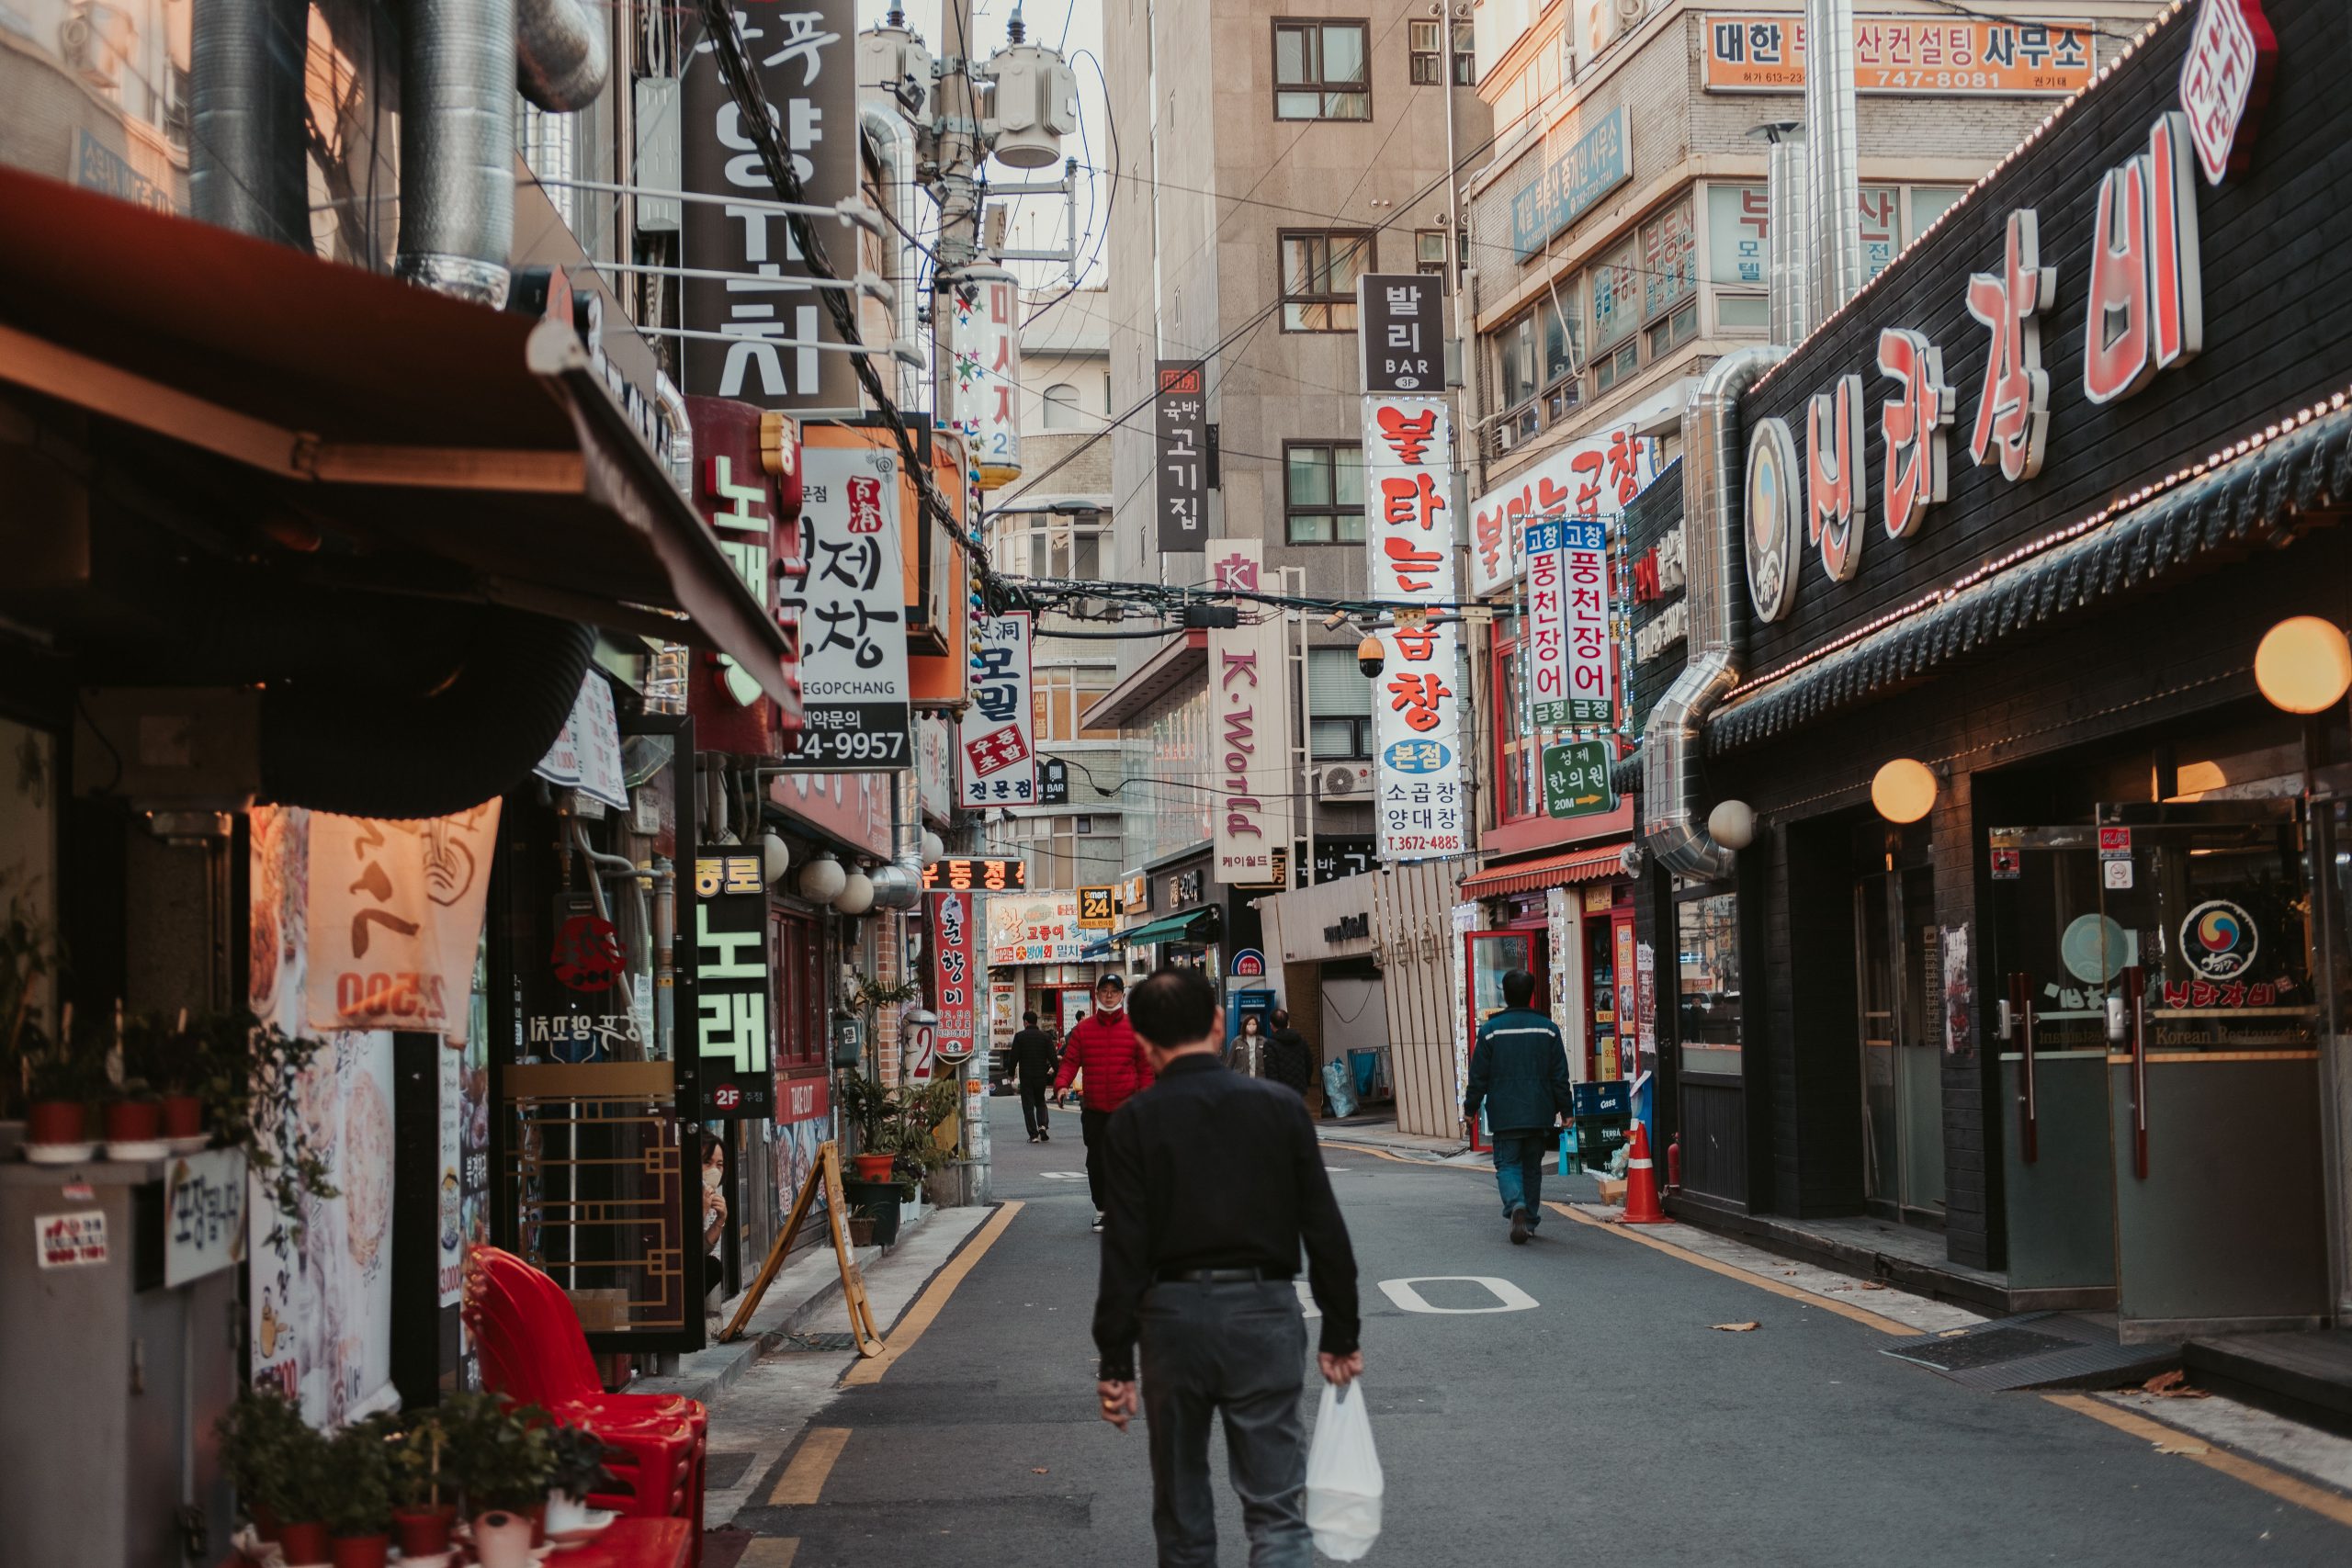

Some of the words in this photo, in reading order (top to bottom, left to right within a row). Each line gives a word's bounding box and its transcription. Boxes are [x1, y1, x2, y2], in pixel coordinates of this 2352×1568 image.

[695, 10, 841, 87] 푸
[1714, 22, 1781, 62] 대한
[1983, 27, 2088, 69] 사무소
[1877, 71, 1999, 88] 747-8081
[1738, 240, 1761, 281] 모텔
[1386, 286, 1422, 354] 발리
[1385, 359, 1430, 374] BAR
[1401, 378, 1415, 388] 3F
[1162, 399, 1200, 422] 육방
[1166, 427, 1199, 531] 고기집
[1529, 525, 1558, 551] 고창
[1566, 525, 1602, 548] 고창
[1532, 552, 1562, 698] 풍천장어
[1569, 552, 1605, 698] 풍천장어
[977, 647, 1021, 723] 모밀
[1534, 701, 1565, 723] 금정
[1573, 700, 1609, 720] 금정
[786, 733, 904, 760] 24-9957
[1392, 743, 1442, 771] 본점
[1558, 747, 1589, 767] 성제
[969, 779, 1033, 799] 전문점
[1046, 783, 1064, 793] BAR
[1548, 765, 1605, 795] 한의원
[1386, 783, 1456, 805] 소곱창
[1554, 796, 1575, 811] 20M
[1387, 807, 1457, 830] 양대창
[1387, 834, 1459, 852] T.3672-4885
[1223, 855, 1269, 868] 케이월드
[1084, 890, 1108, 899] emart
[1085, 898, 1110, 918] 24
[1027, 924, 1065, 942] 고등어
[939, 911, 966, 1005] 춘향이
[695, 904, 767, 1073] 노래
[2155, 1028, 2211, 1045] Korean
[717, 1089, 739, 1106] 2F
[1600, 1098, 1616, 1110] Cass
[1601, 1127, 1622, 1138] TERRA
